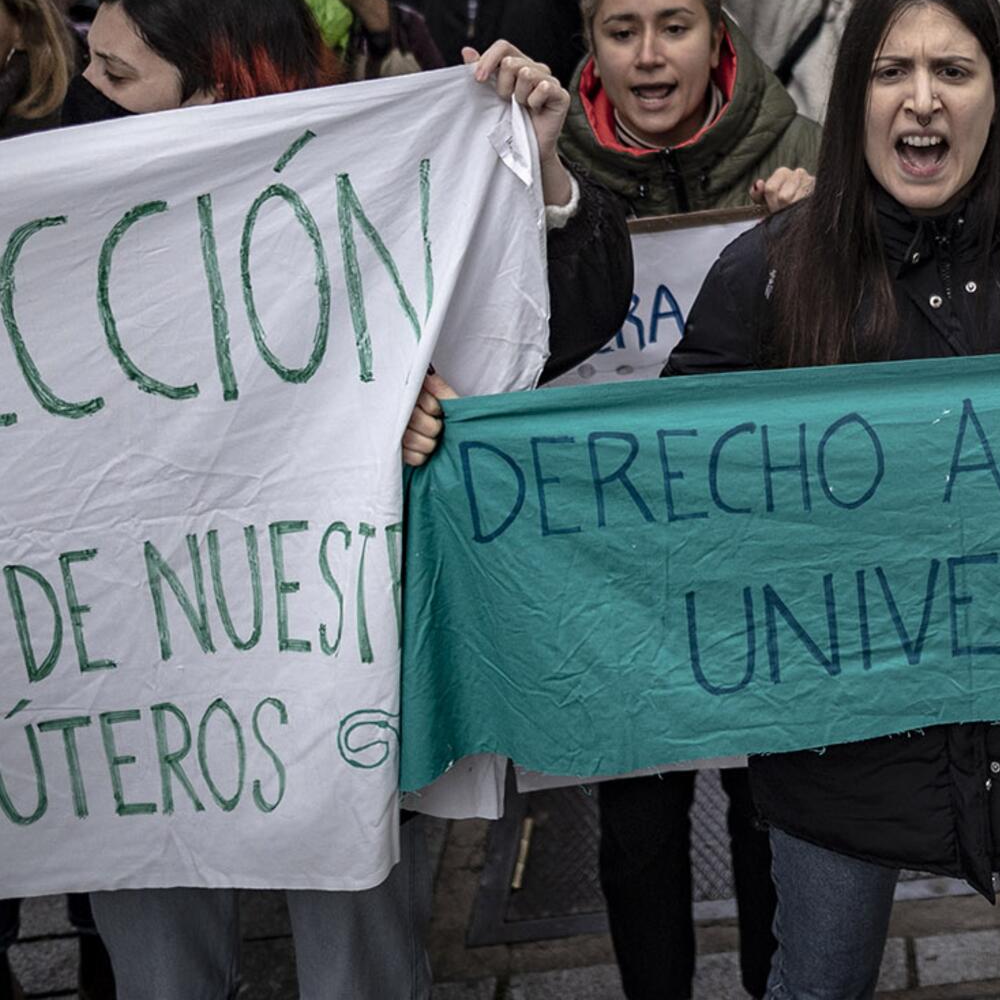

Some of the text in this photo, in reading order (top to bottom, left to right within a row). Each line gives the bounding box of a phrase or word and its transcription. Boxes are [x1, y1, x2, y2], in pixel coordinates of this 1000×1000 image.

[0, 130, 434, 426] CCIÓN
[598, 284, 686, 354] RA
[459, 412, 885, 544] DERECHO
[3, 548, 117, 683] DE
[0, 696, 289, 826] ÚTEROS
